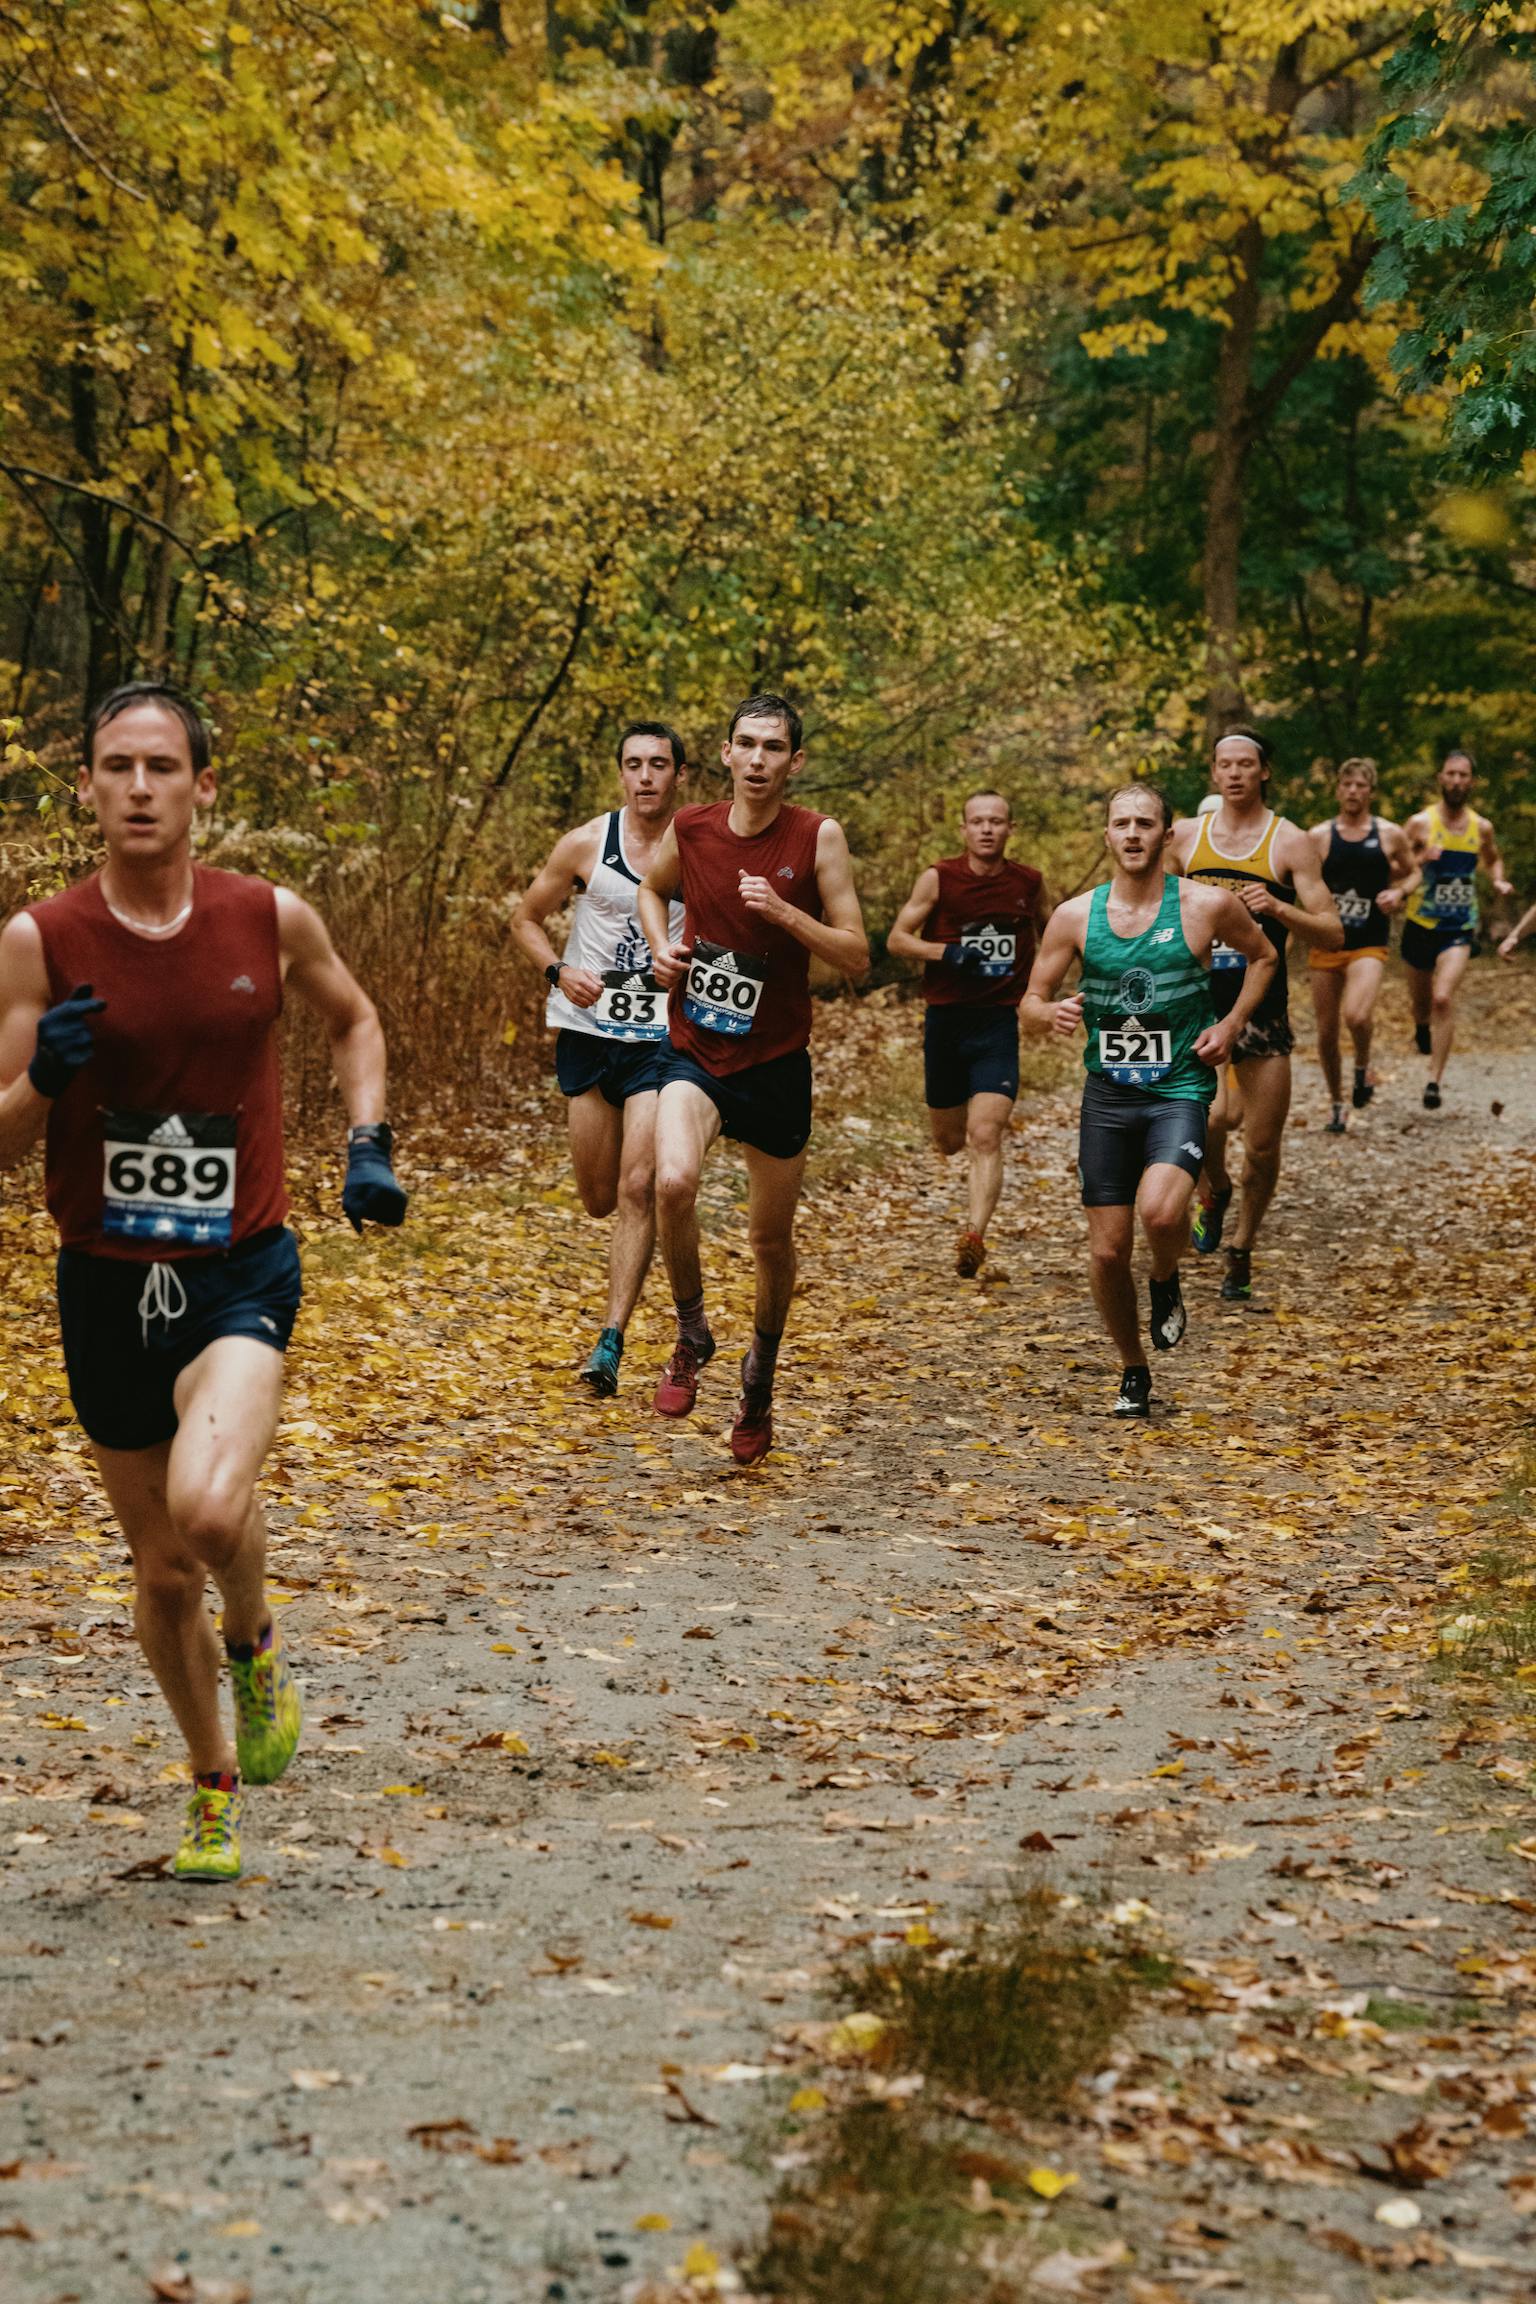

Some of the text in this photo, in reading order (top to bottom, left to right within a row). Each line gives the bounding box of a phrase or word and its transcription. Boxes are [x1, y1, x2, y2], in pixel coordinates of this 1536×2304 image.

[691, 965, 756, 1010] 680
[609, 992, 656, 1023] 83
[1104, 1034, 1164, 1062] 521
[110, 1151, 229, 1201] 689
